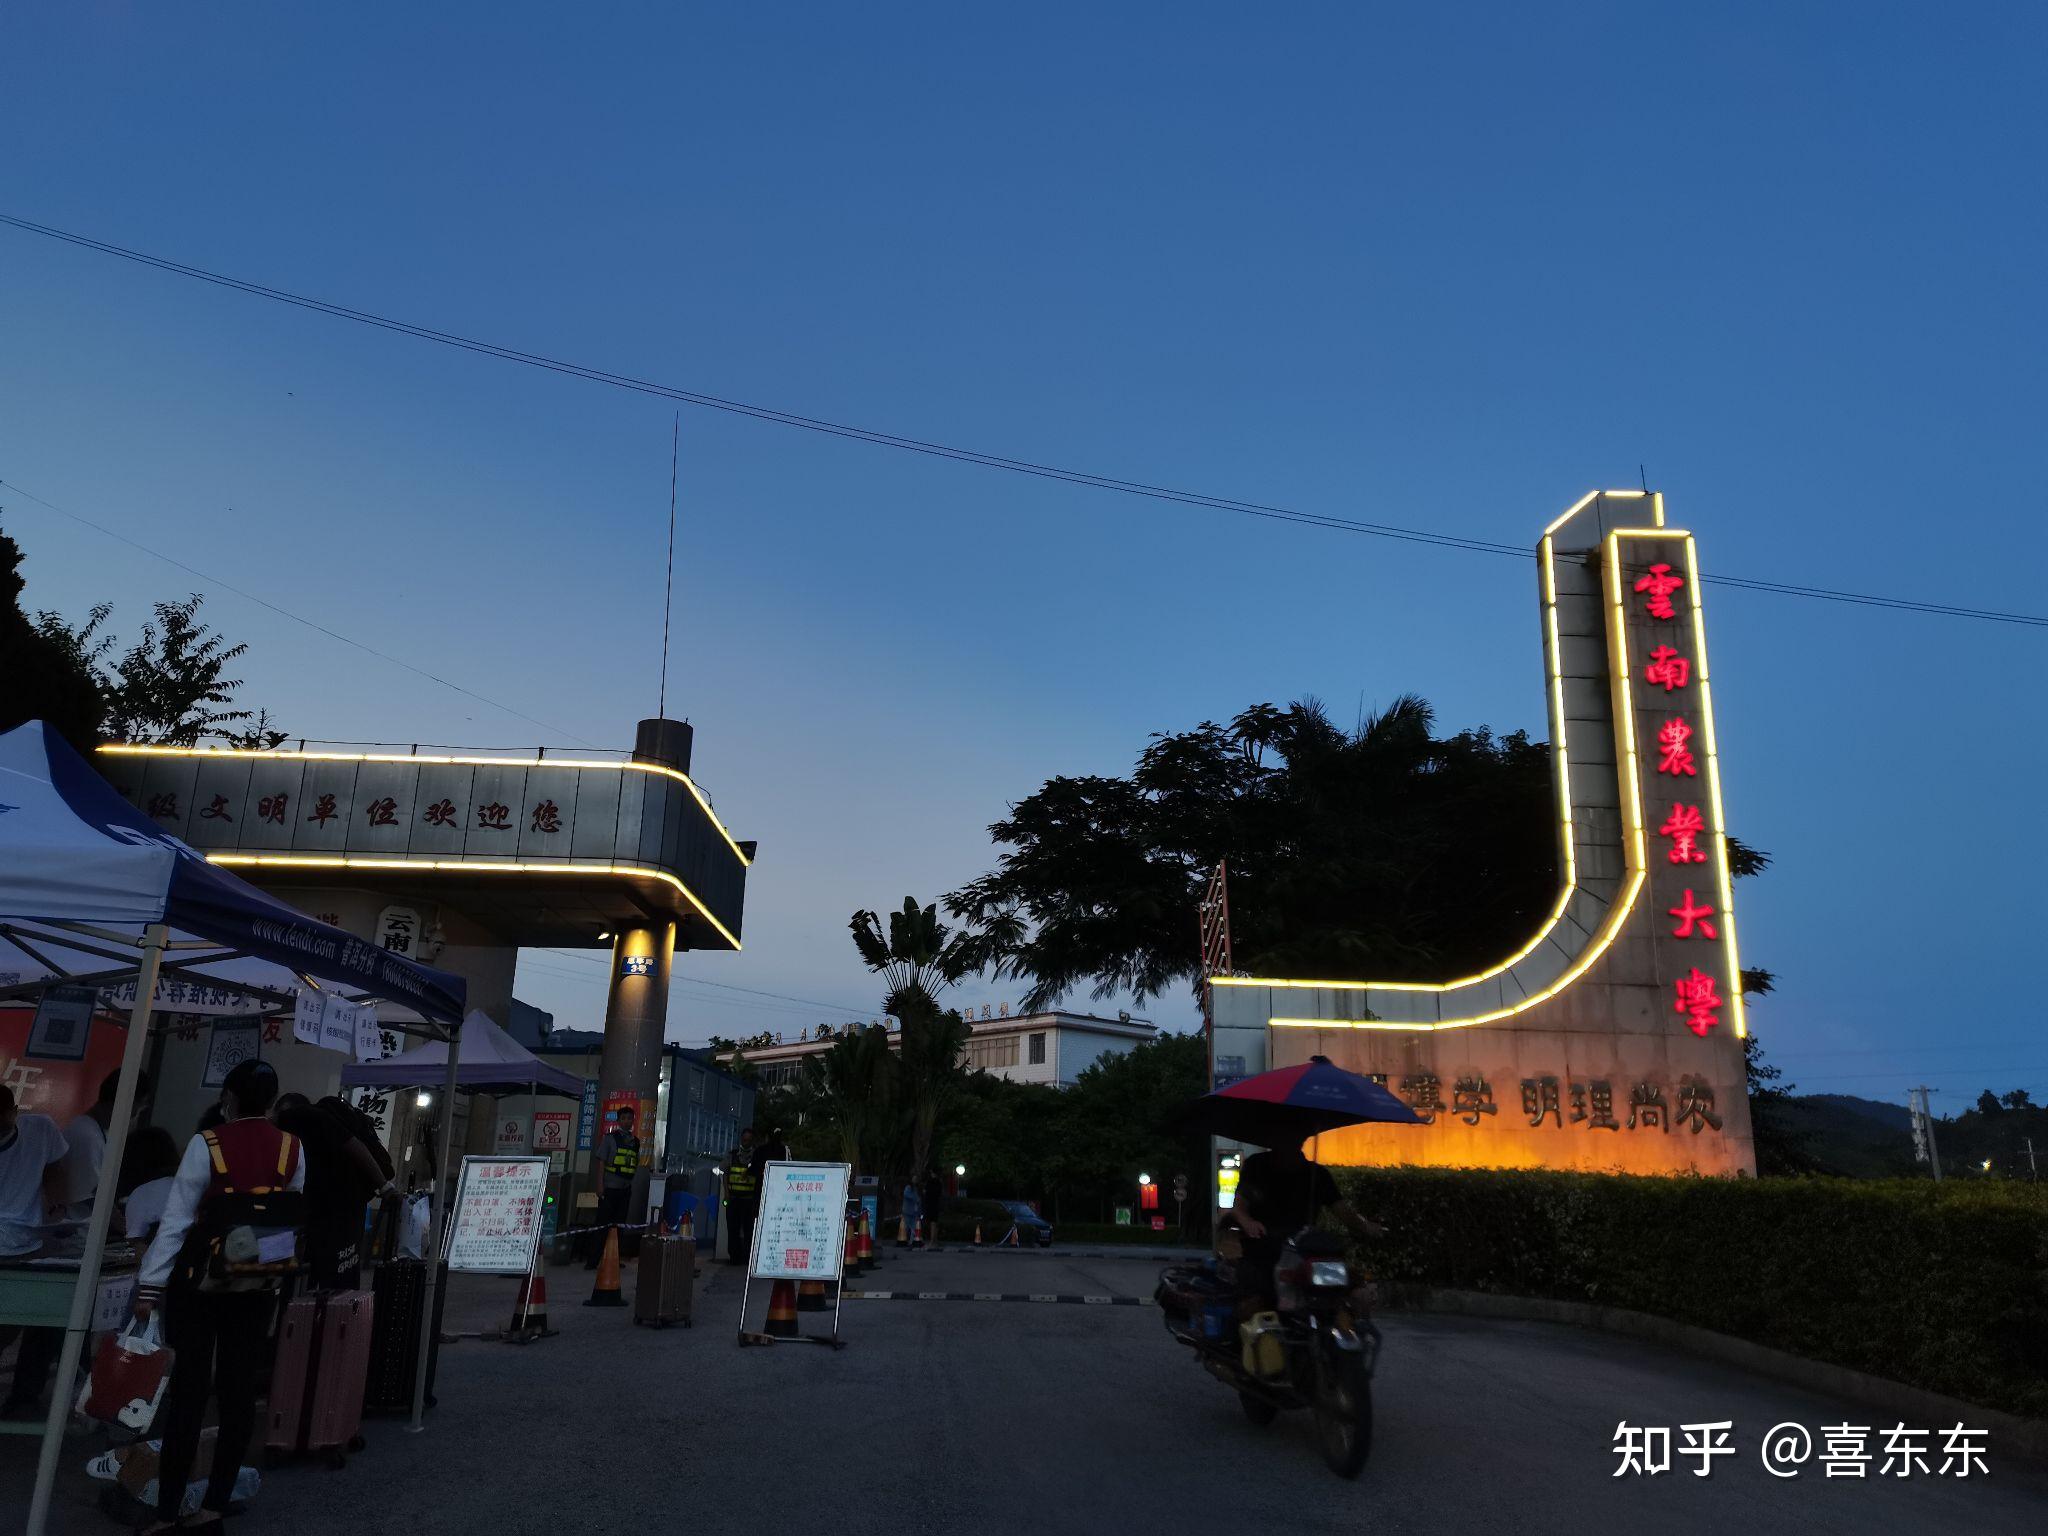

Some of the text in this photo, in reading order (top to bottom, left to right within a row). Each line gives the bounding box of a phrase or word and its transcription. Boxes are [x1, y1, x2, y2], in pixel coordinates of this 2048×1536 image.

[117, 787, 563, 833] 级文明单位欢迎您
